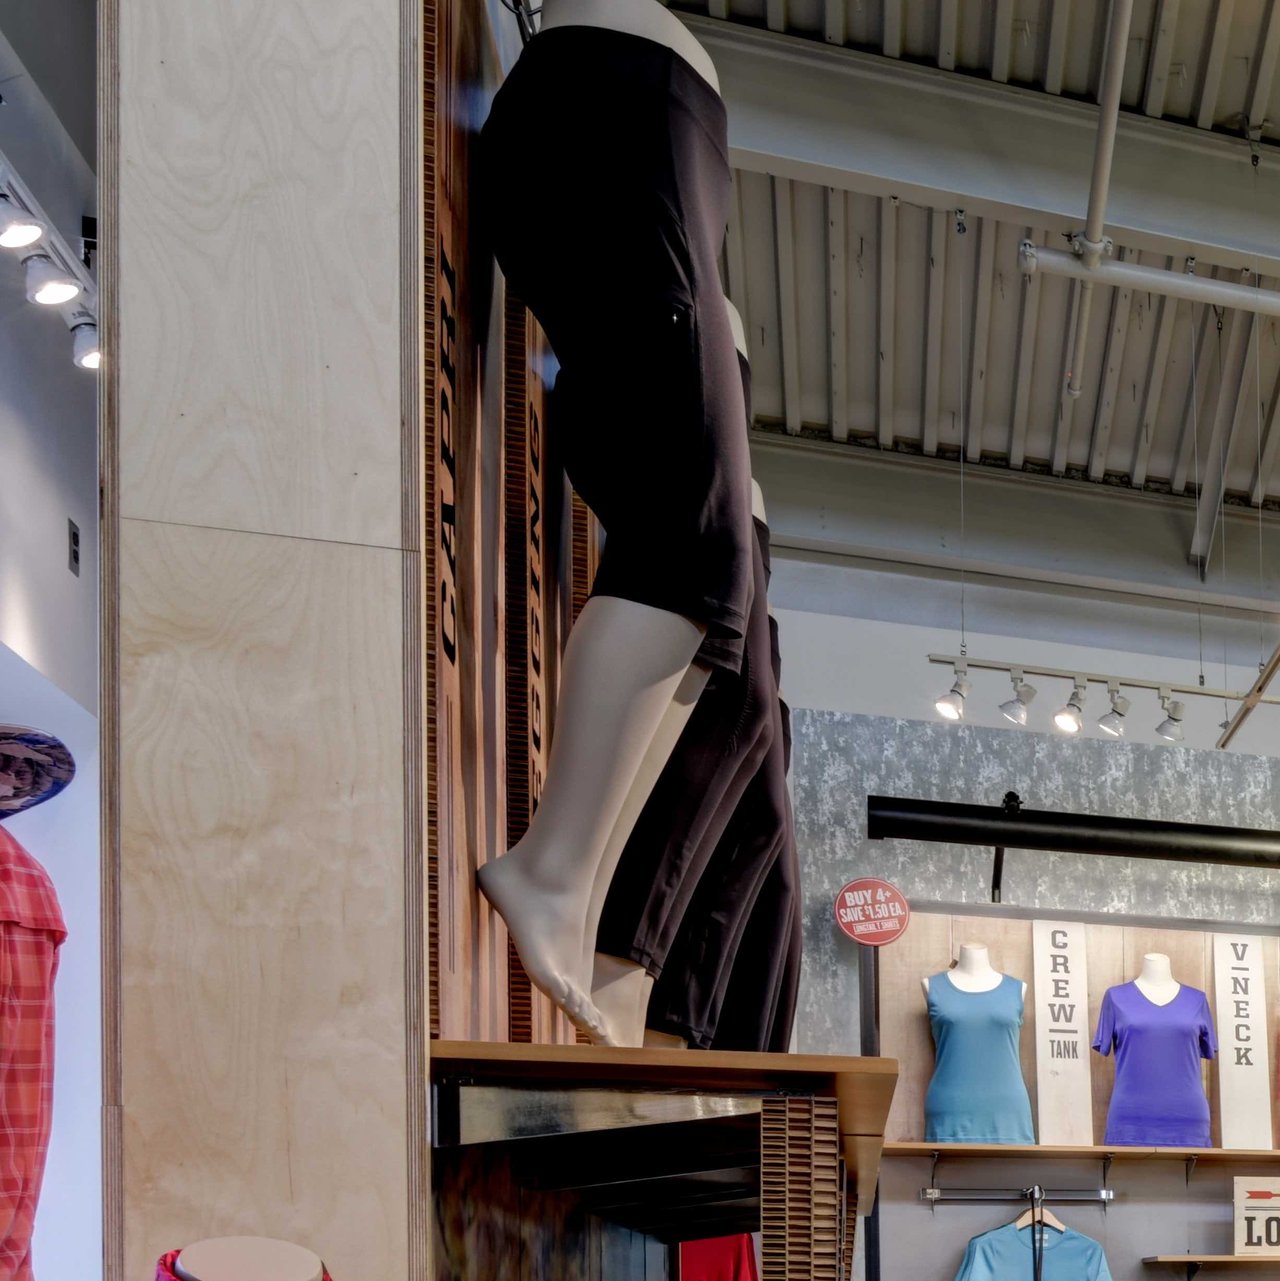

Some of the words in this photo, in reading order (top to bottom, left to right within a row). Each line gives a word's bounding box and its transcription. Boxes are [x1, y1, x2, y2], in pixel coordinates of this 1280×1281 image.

[440, 245, 457, 667] CAPRI
[844, 889, 872, 907] BUY
[840, 906, 865, 923] SAVE
[864, 904, 889, 919] $1.50
[1048, 930, 1076, 1023] CREW
[1049, 1040, 1079, 1060] TANK
